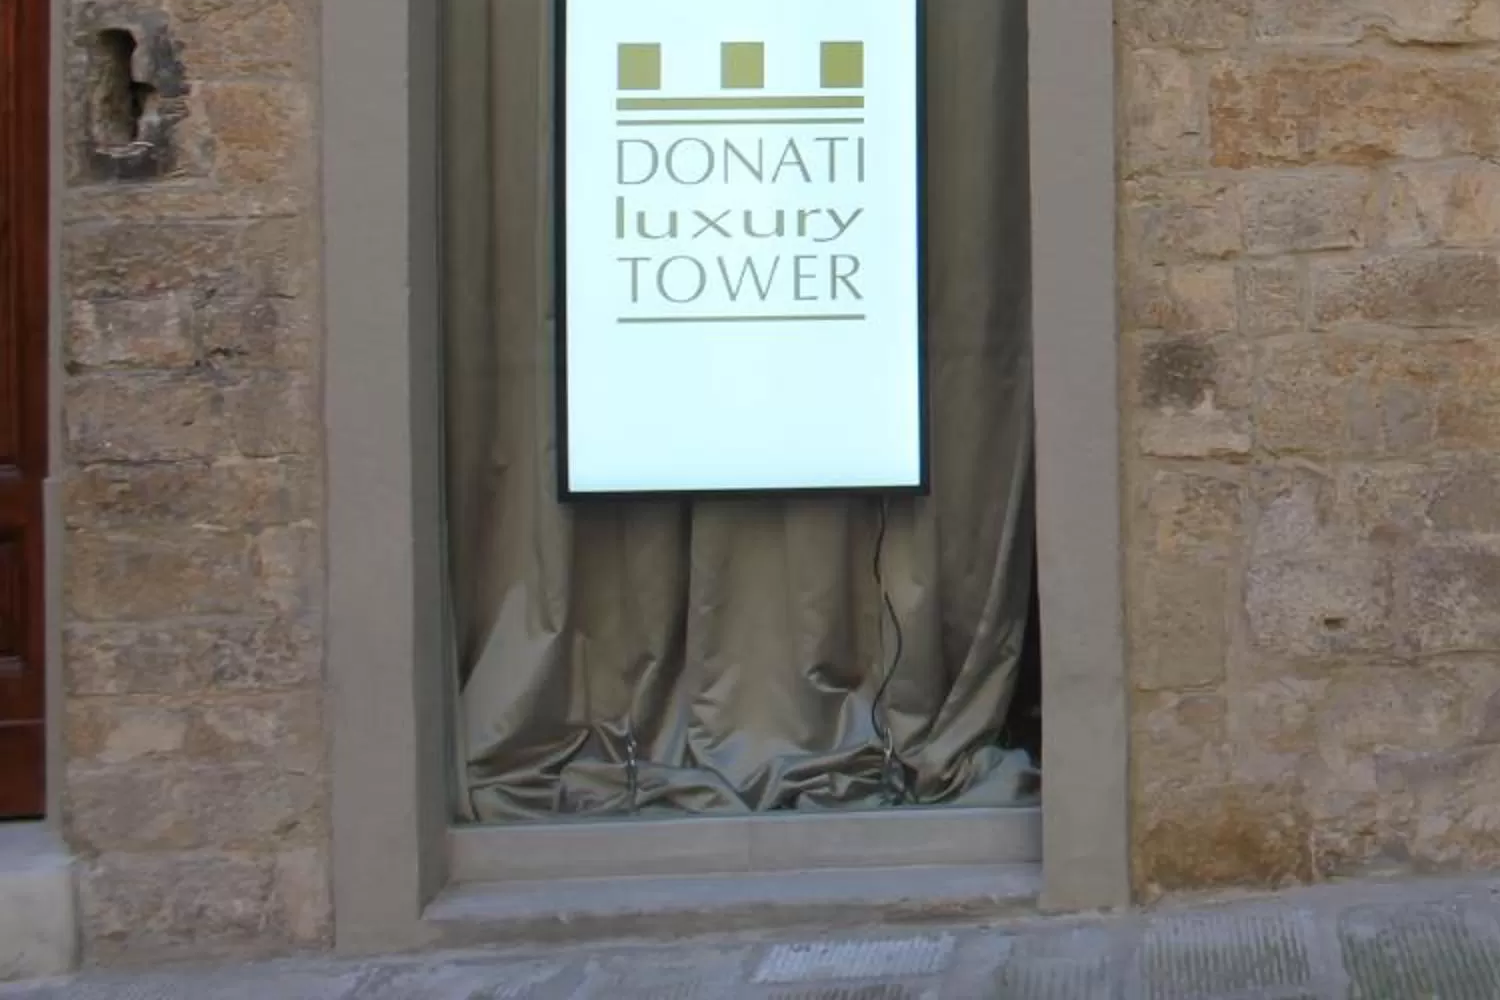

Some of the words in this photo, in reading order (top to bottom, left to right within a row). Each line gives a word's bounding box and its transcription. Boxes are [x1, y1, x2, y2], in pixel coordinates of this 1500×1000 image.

[616, 136, 865, 185] DONATI
[615, 195, 864, 243] luxury
[616, 254, 864, 304] TOWER
